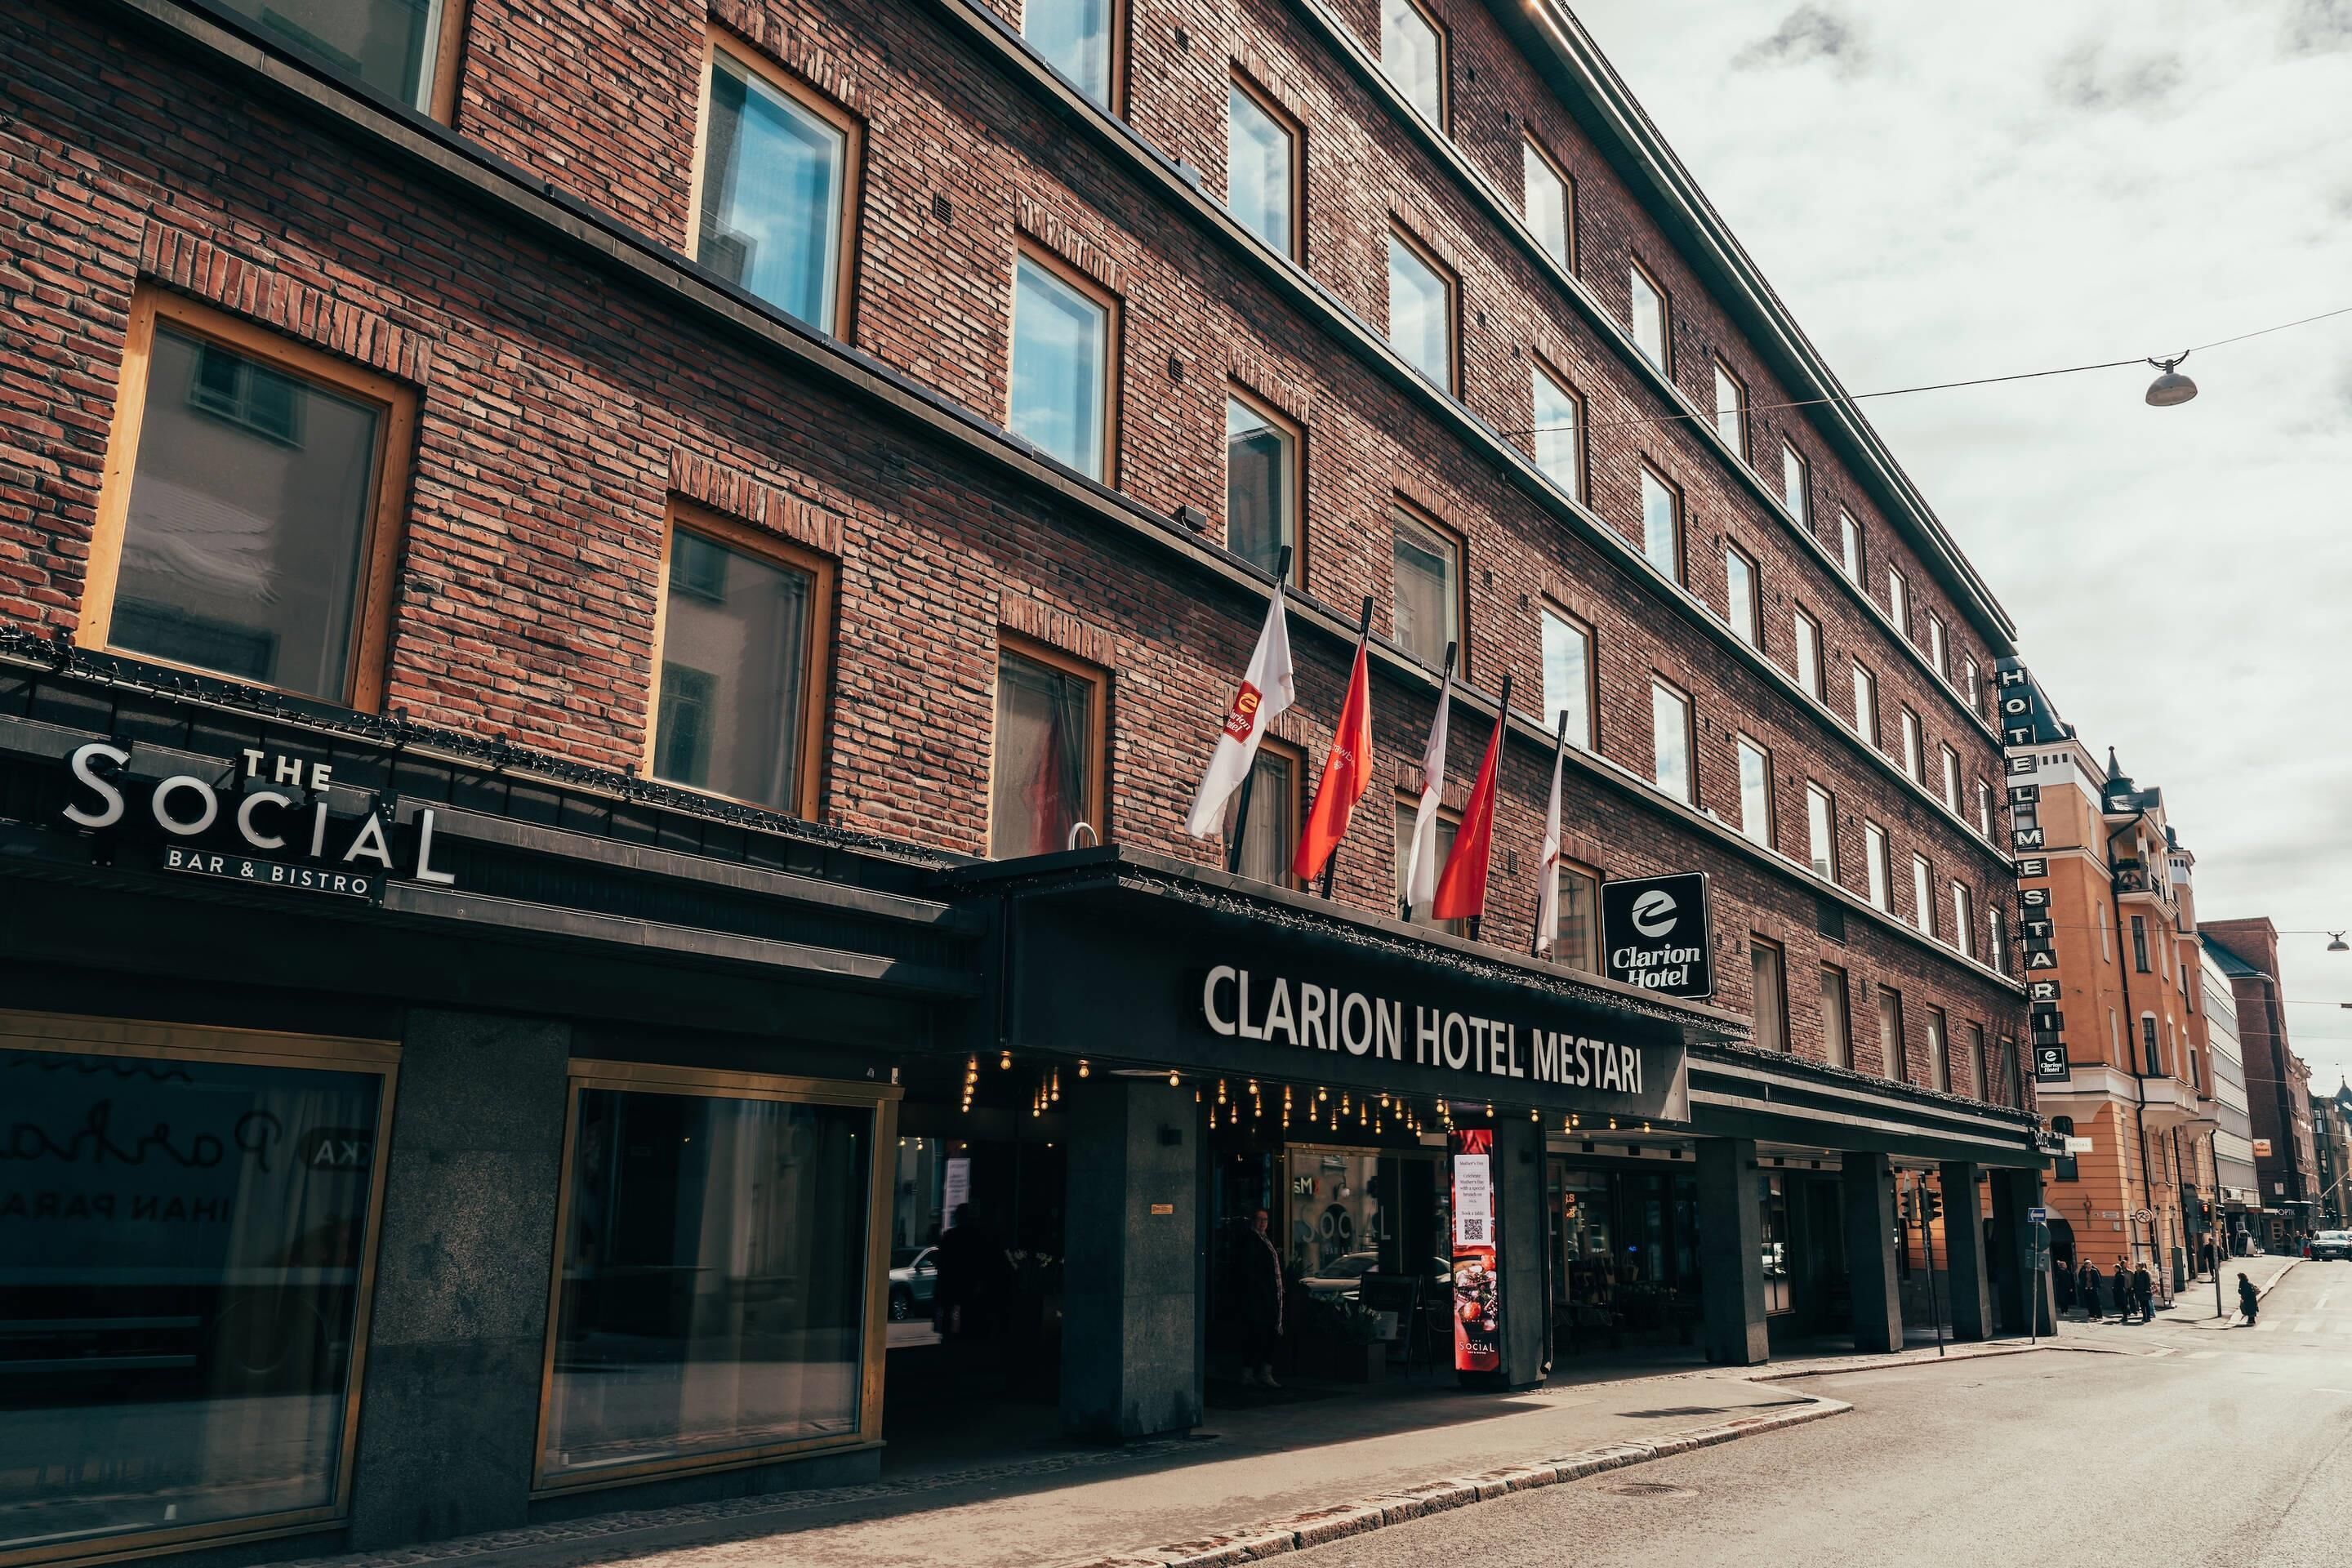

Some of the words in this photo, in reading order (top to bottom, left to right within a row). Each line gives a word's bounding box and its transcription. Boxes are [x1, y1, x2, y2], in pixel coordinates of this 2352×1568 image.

[2002, 669, 2034, 802] HOTEL
[243, 748, 332, 791] THE
[62, 742, 456, 884] SOCIAL
[167, 849, 224, 874] BAR
[240, 861, 255, 879] &
[271, 865, 368, 895] BISTRO
[2017, 829, 2053, 1031] MESTARI
[1612, 943, 1701, 969] Clarion
[1628, 964, 1690, 989] Hotel
[1203, 964, 1402, 1061] CLARION
[1415, 1005, 1526, 1078] HOTEL
[1532, 1027, 1643, 1094] MESTARI
[1459, 1341, 1495, 1352] SOCIAL
